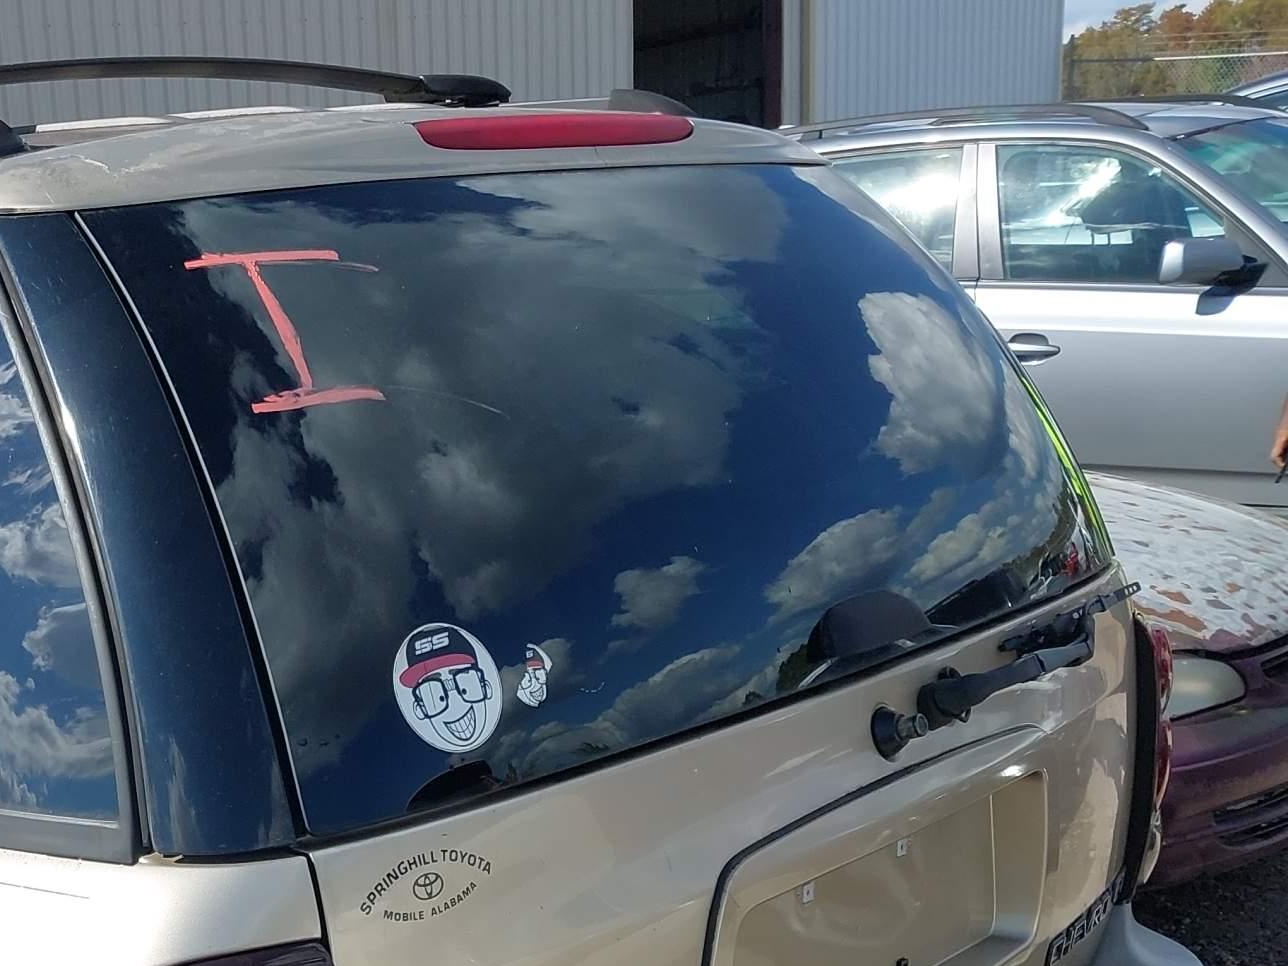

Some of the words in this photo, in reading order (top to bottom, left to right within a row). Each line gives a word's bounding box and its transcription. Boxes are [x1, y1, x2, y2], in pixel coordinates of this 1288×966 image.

[360, 850, 438, 915] SPRINGHILL
[440, 849, 492, 875] TOYOTA
[383, 909, 425, 922] MOBILE
[431, 881, 477, 917] ALABAMA
